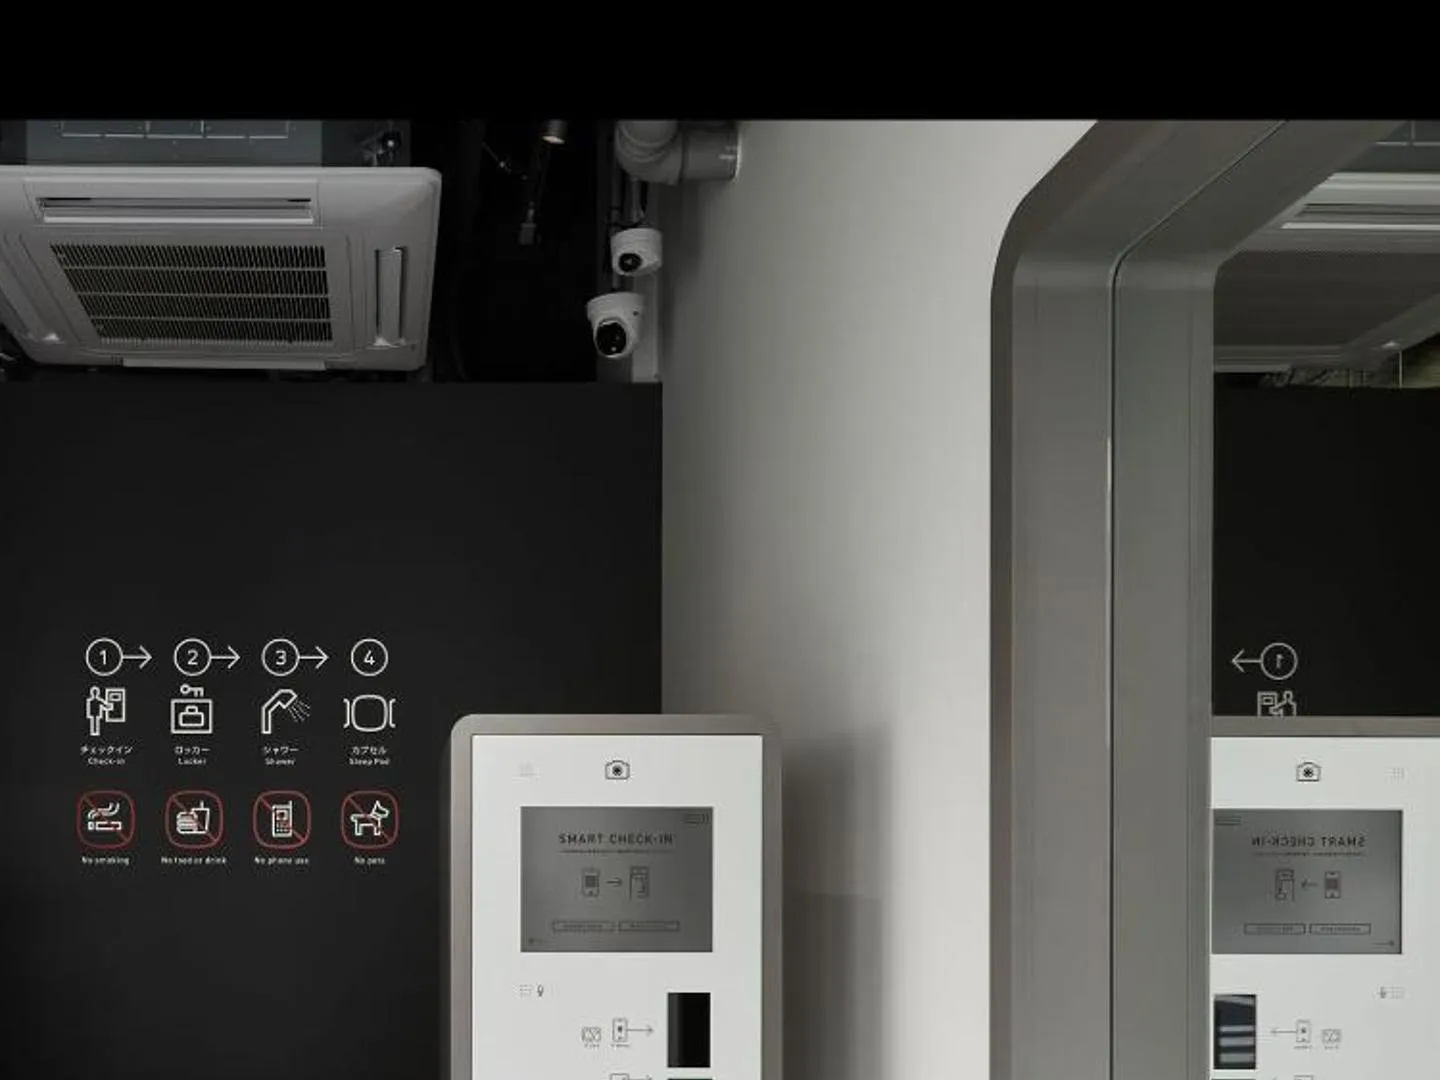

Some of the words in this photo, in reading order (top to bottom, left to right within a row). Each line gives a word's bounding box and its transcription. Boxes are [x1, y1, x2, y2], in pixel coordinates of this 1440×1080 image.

[100, 649, 107, 665] 1
[187, 649, 199, 665] 2
[275, 649, 287, 665] 3
[363, 649, 376, 665] 4
[558, 832, 603, 845] SMART
[609, 832, 674, 845] CHECK-IN
